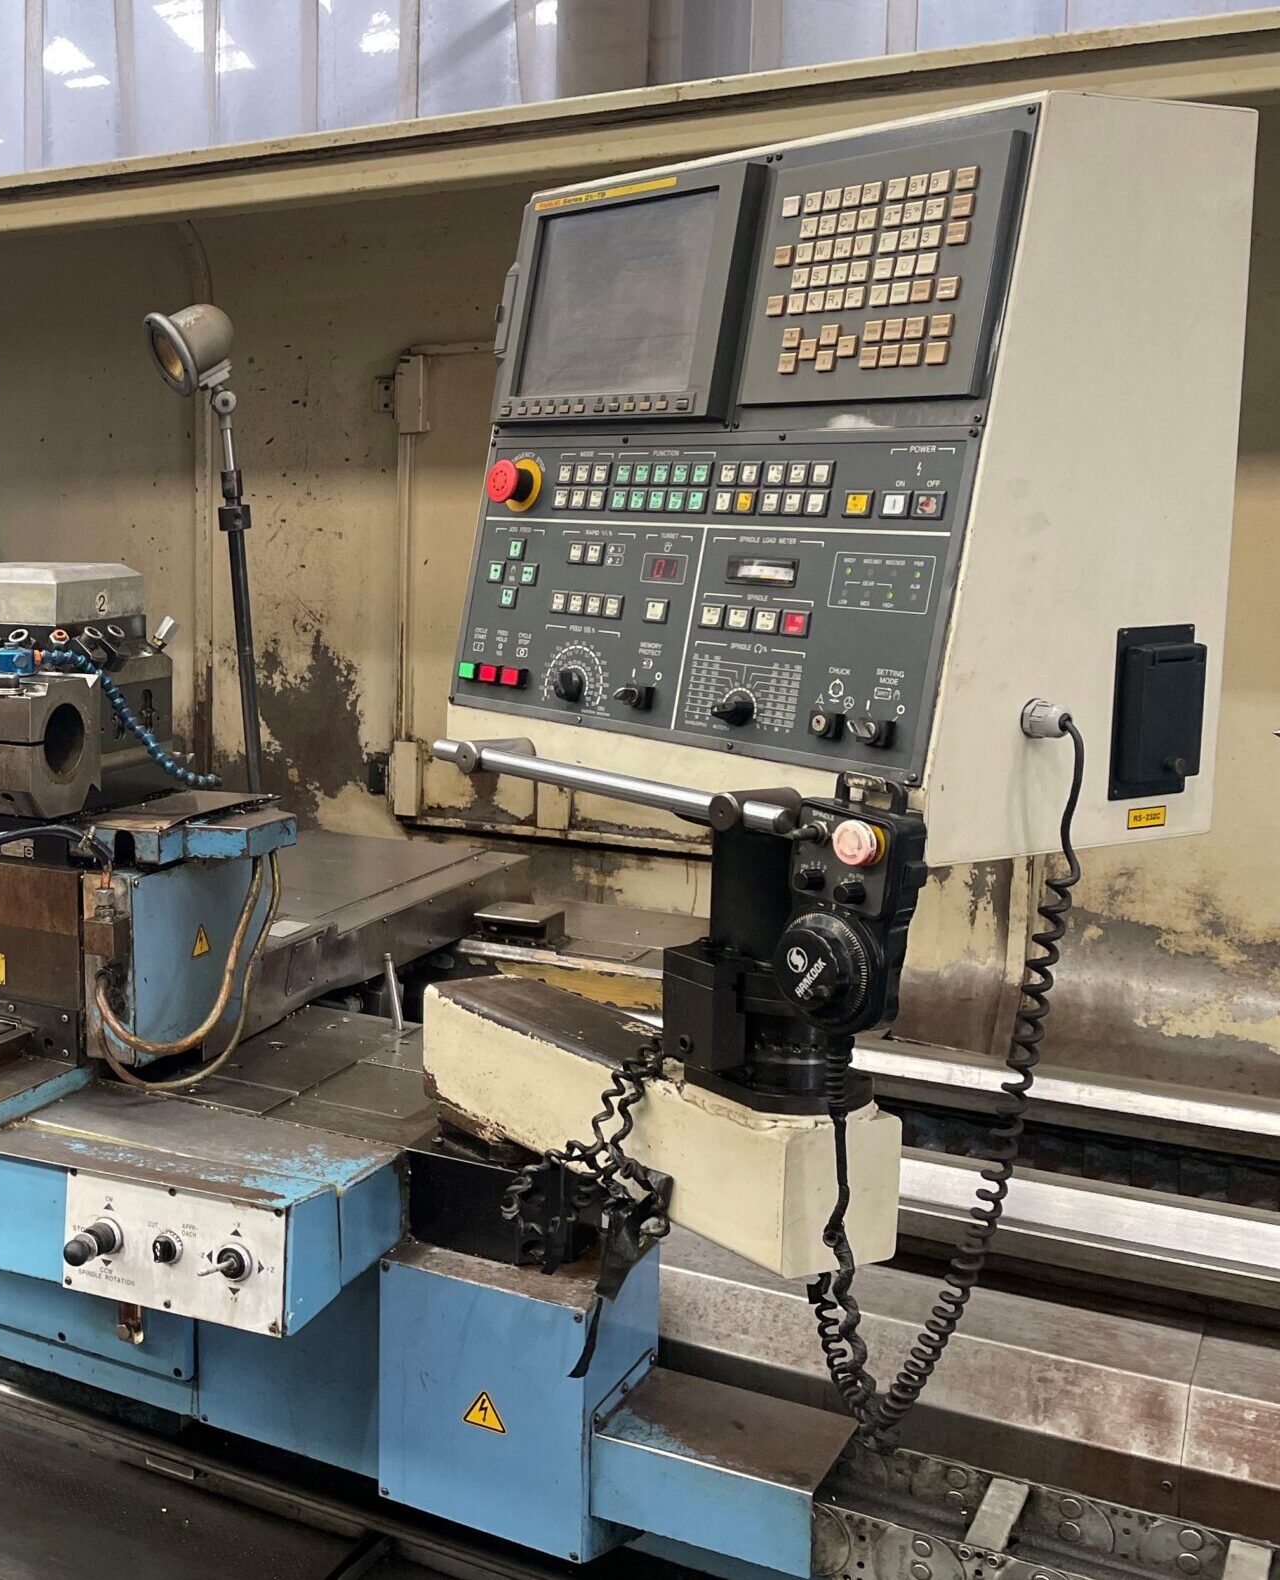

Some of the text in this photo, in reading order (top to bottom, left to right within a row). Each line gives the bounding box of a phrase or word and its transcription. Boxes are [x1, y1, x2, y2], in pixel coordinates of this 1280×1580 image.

[909, 445, 937, 453] POWER
[927, 480, 941, 488] OFF
[652, 559, 678, 578] 01
[98, 595, 105, 612] 2
[730, 642, 752, 651] SPINDLE
[828, 666, 851, 675] CHUCK
[876, 668, 905, 678] SETTING
[879, 677, 899, 685] MODE
[812, 810, 835, 821] SPINDLE
[1133, 812, 1161, 822] RS-232C
[794, 957, 827, 997] HANKOOK
[147, 1220, 159, 1228] CUT
[100, 1266, 113, 1274] CCW
[78, 1268, 136, 1286] SPINDLE ROTATION
